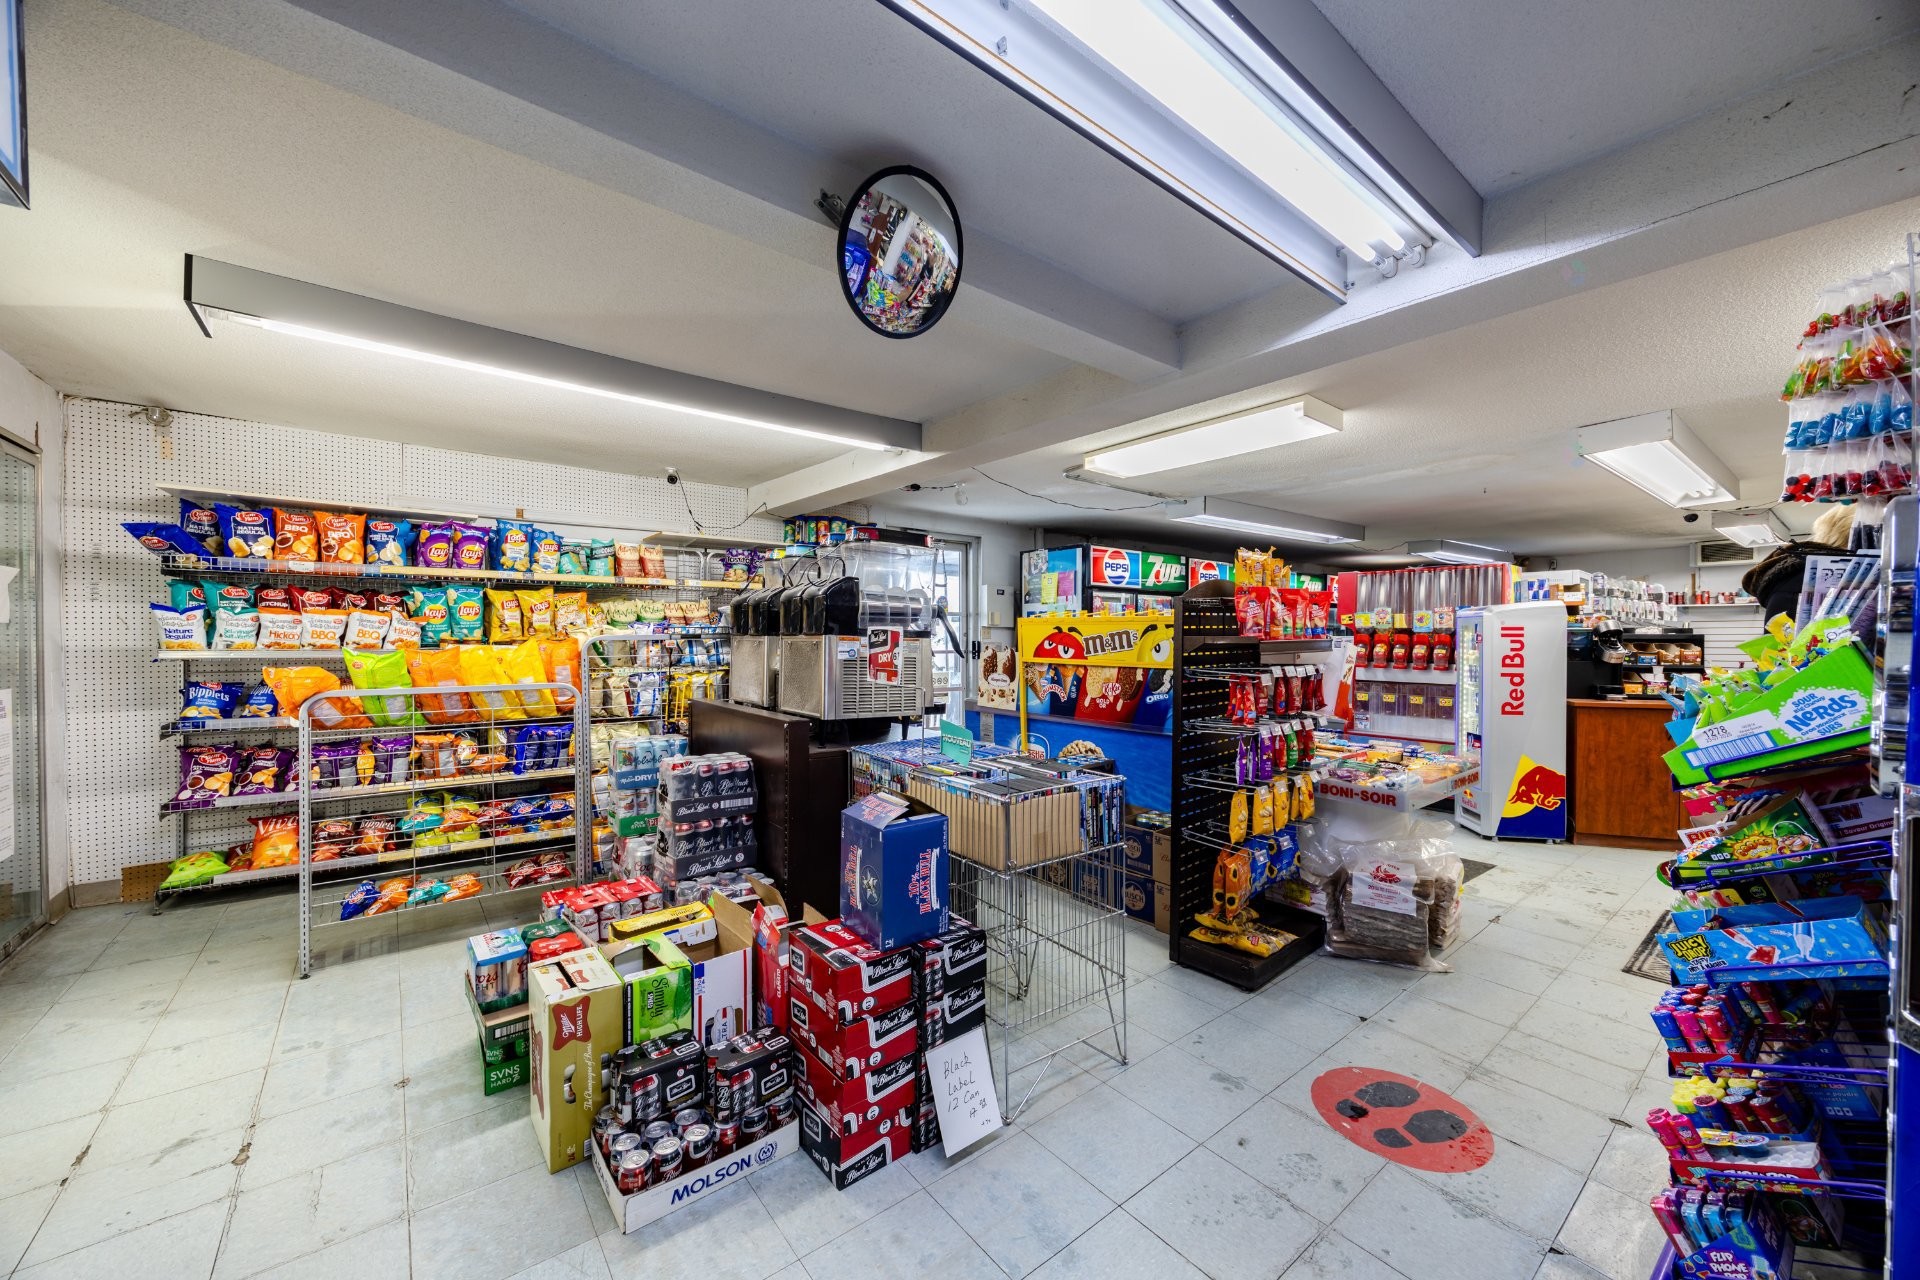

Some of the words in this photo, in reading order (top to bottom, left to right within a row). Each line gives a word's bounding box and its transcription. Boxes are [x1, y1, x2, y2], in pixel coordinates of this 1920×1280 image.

[1104, 562, 1129, 573] PEPSI
[1200, 572, 1219, 580] PEPSI
[164, 633, 194, 641] Regular
[311, 629, 337, 640] BBQ
[356, 629, 381, 640] BBQ
[1501, 626, 1524, 669] Bull
[878, 652, 892, 663] DRY
[189, 687, 229, 702] Ripplets
[1040, 684, 1068, 703] DRUMSTICK
[1146, 693, 1169, 703] OREO
[1501, 672, 1524, 716] Red
[1792, 693, 1819, 708] SOUR
[1703, 725, 1728, 739] 1278
[1818, 721, 1844, 736] SURS
[942, 733, 971, 748] NOUVEAU
[634, 772, 653, 781] DRY
[1453, 771, 1479, 789] BONI-SOIR
[1320, 783, 1397, 807] BONI-SOIR
[676, 806, 695, 816] Black
[694, 803, 711, 812] Label
[687, 861, 712, 876] Black
[712, 854, 732, 868] Label
[919, 848, 931, 875] BULL
[919, 874, 931, 915] BLACK
[841, 933, 855, 941] DRY
[952, 949, 970, 962] Black
[969, 939, 985, 953] Label
[1671, 935, 1707, 956] JUICY
[1682, 946, 1706, 961] DROP
[872, 962, 893, 979] Black
[892, 955, 909, 969] Label
[476, 982, 495, 991] GHT
[650, 977, 669, 1018] Simply
[951, 998, 969, 1010] Black
[968, 987, 983, 1002] Label
[561, 1012, 575, 1038] Miller
[879, 1017, 899, 1034] Black
[897, 1007, 915, 1022] Label
[490, 1065, 520, 1081] SVNS
[876, 1070, 897, 1088] Black
[895, 1059, 913, 1074] Label
[490, 1077, 513, 1088] HARD
[583, 1067, 596, 1099] Champagne
[583, 1098, 593, 1111] The
[845, 1166, 868, 1185] Black
[866, 1153, 884, 1170] Label
[670, 1155, 752, 1205] MOLSON
[1710, 1252, 1734, 1263] FLIP
[1710, 1263, 1749, 1274] PHONE
